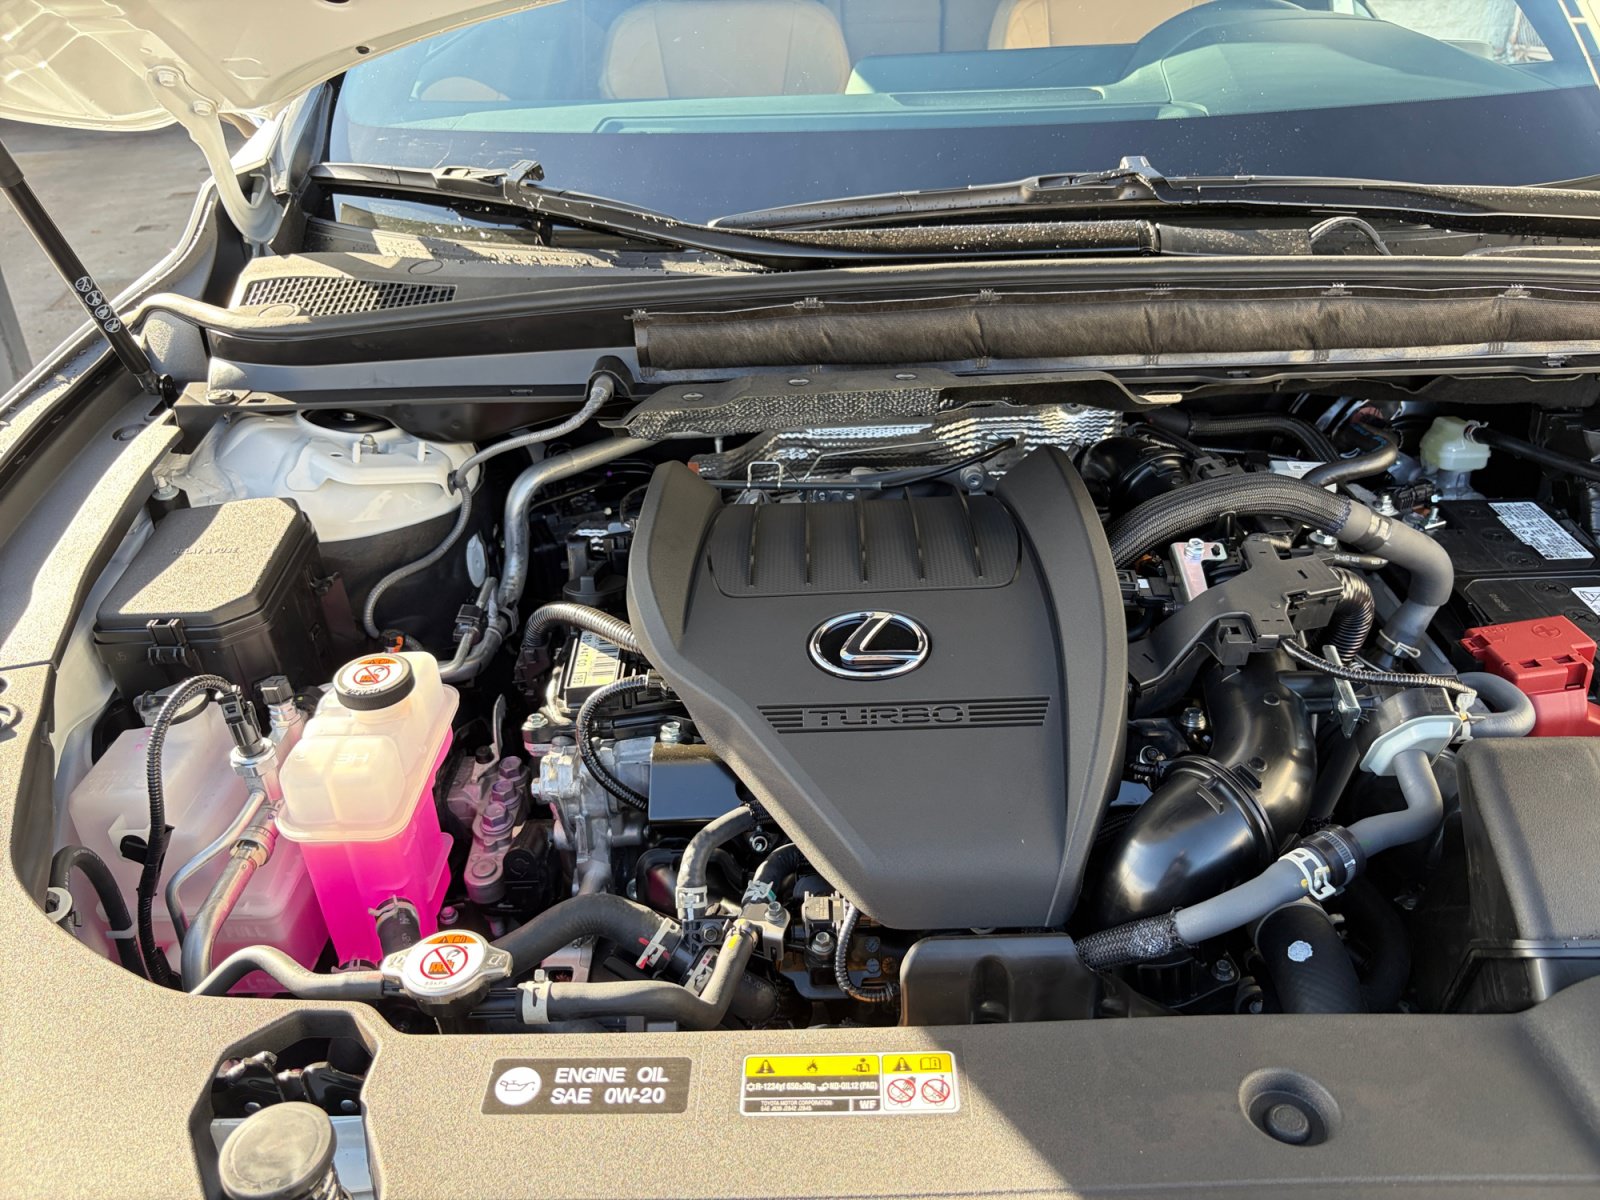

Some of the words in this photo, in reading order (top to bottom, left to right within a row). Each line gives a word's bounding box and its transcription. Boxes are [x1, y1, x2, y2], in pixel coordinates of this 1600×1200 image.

[808, 704, 964, 726] TURBO
[553, 1066, 628, 1084] ENGINE
[636, 1066, 669, 1083] OIL
[550, 1087, 592, 1105] SAE
[604, 1087, 666, 1104] 0W-20
[859, 1100, 876, 1109] WF
